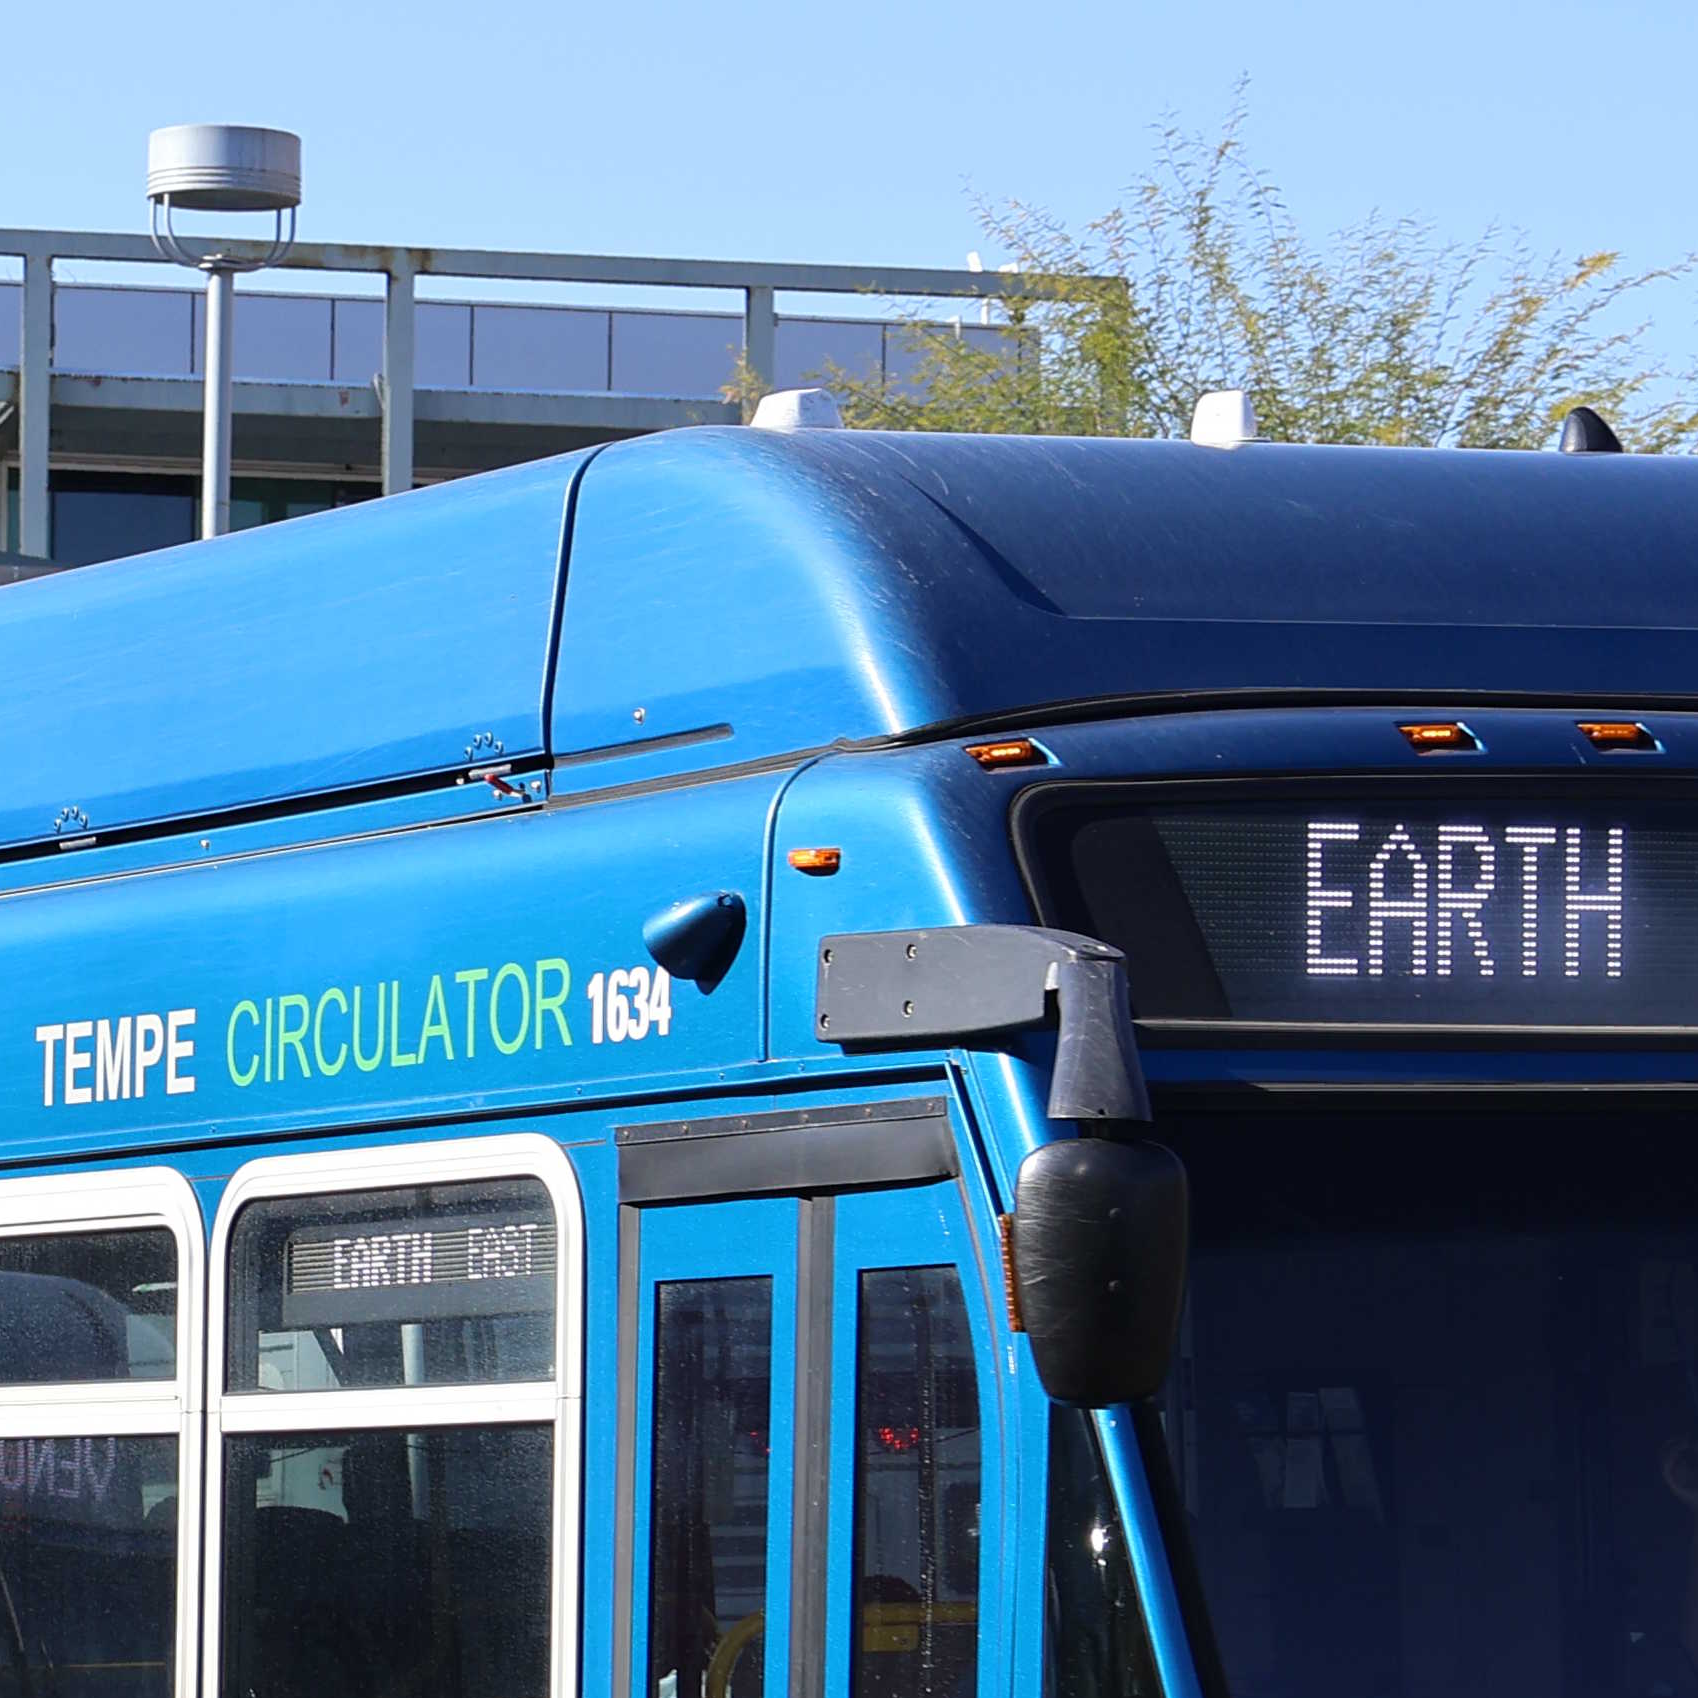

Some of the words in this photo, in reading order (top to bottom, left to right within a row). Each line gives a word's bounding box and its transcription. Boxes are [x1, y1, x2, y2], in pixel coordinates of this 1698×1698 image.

[1306, 822, 1624, 978] EARTH
[35, 1008, 196, 1107] TEMPE
[226, 957, 573, 1088] CIRCULATOR
[586, 965, 672, 1045] 1634
[333, 1231, 432, 1289] EARTH
[467, 1223, 538, 1281] EAST
